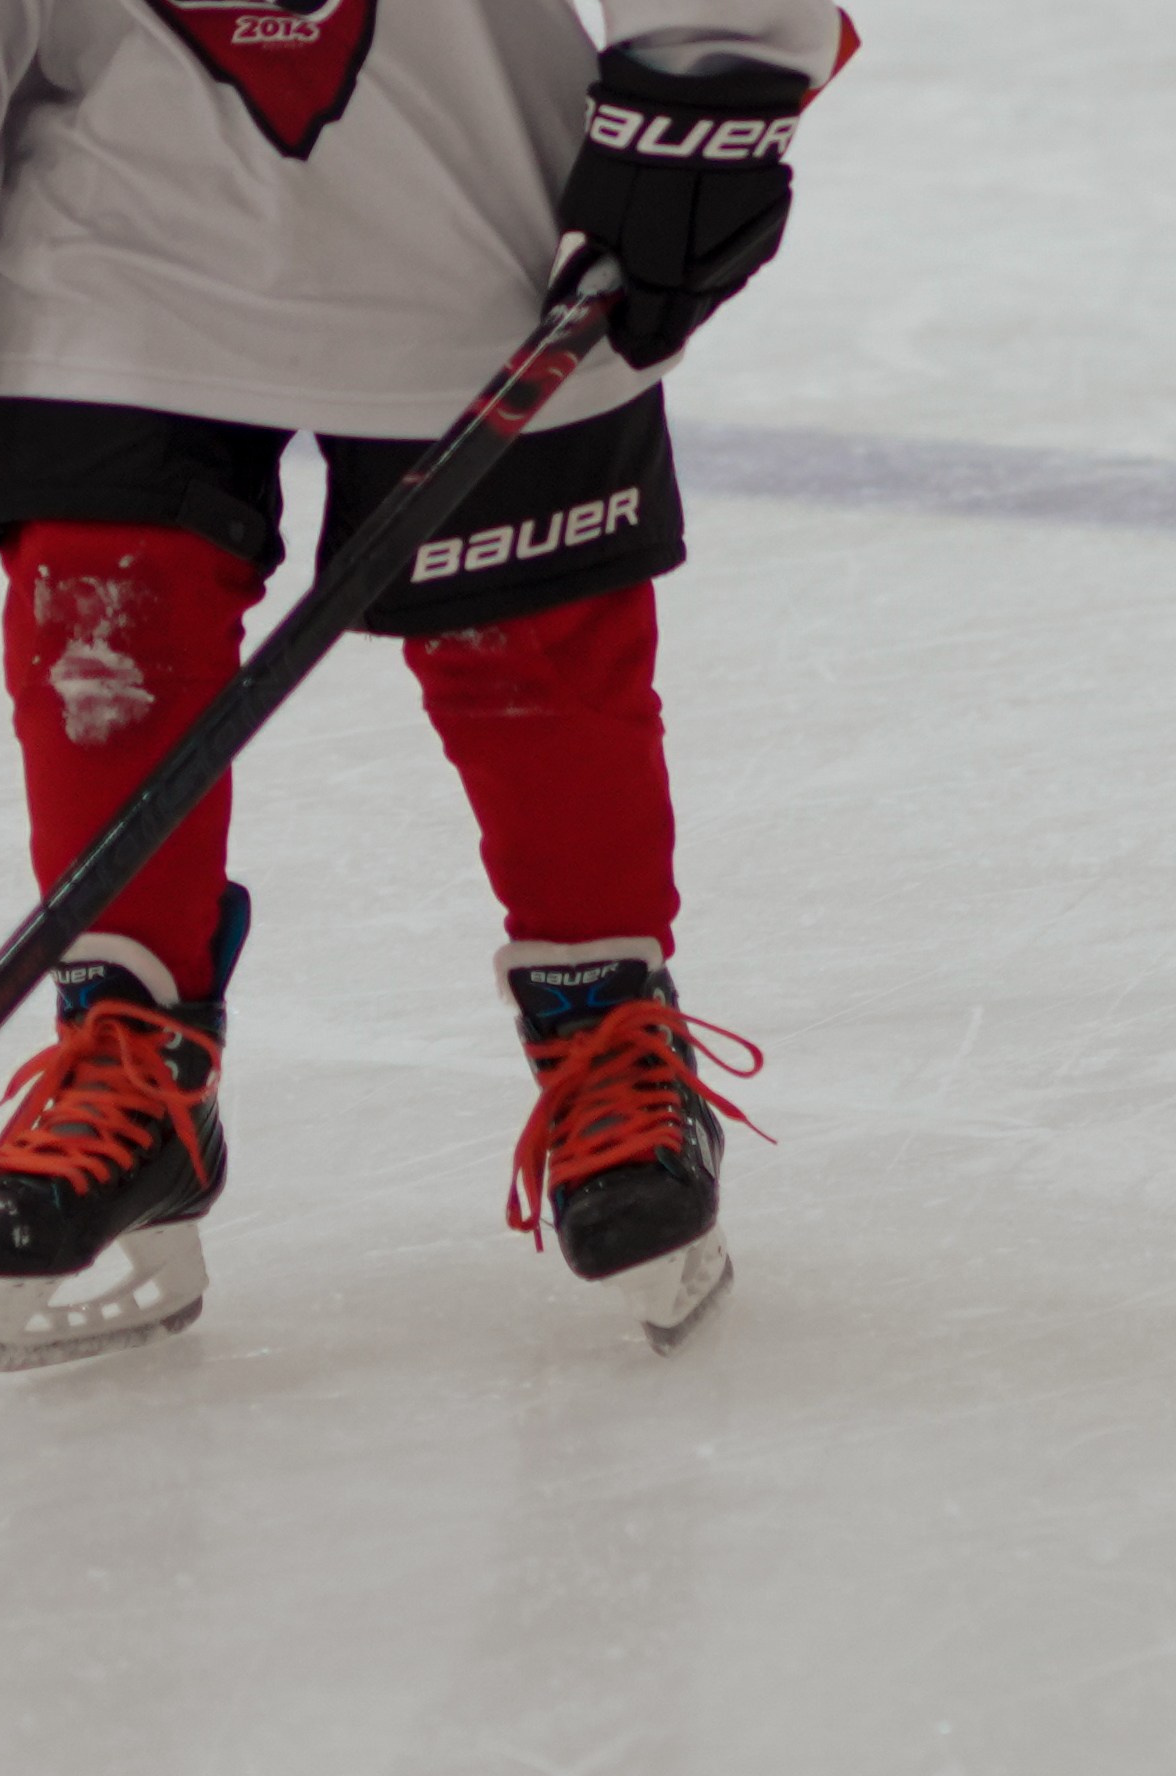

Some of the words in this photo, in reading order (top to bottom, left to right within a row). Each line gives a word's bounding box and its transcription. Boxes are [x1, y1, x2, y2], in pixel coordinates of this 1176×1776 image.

[585, 96, 801, 160] AUER
[409, 486, 640, 584] BAUER
[50, 965, 105, 985] UER
[530, 962, 619, 986] BAUER
